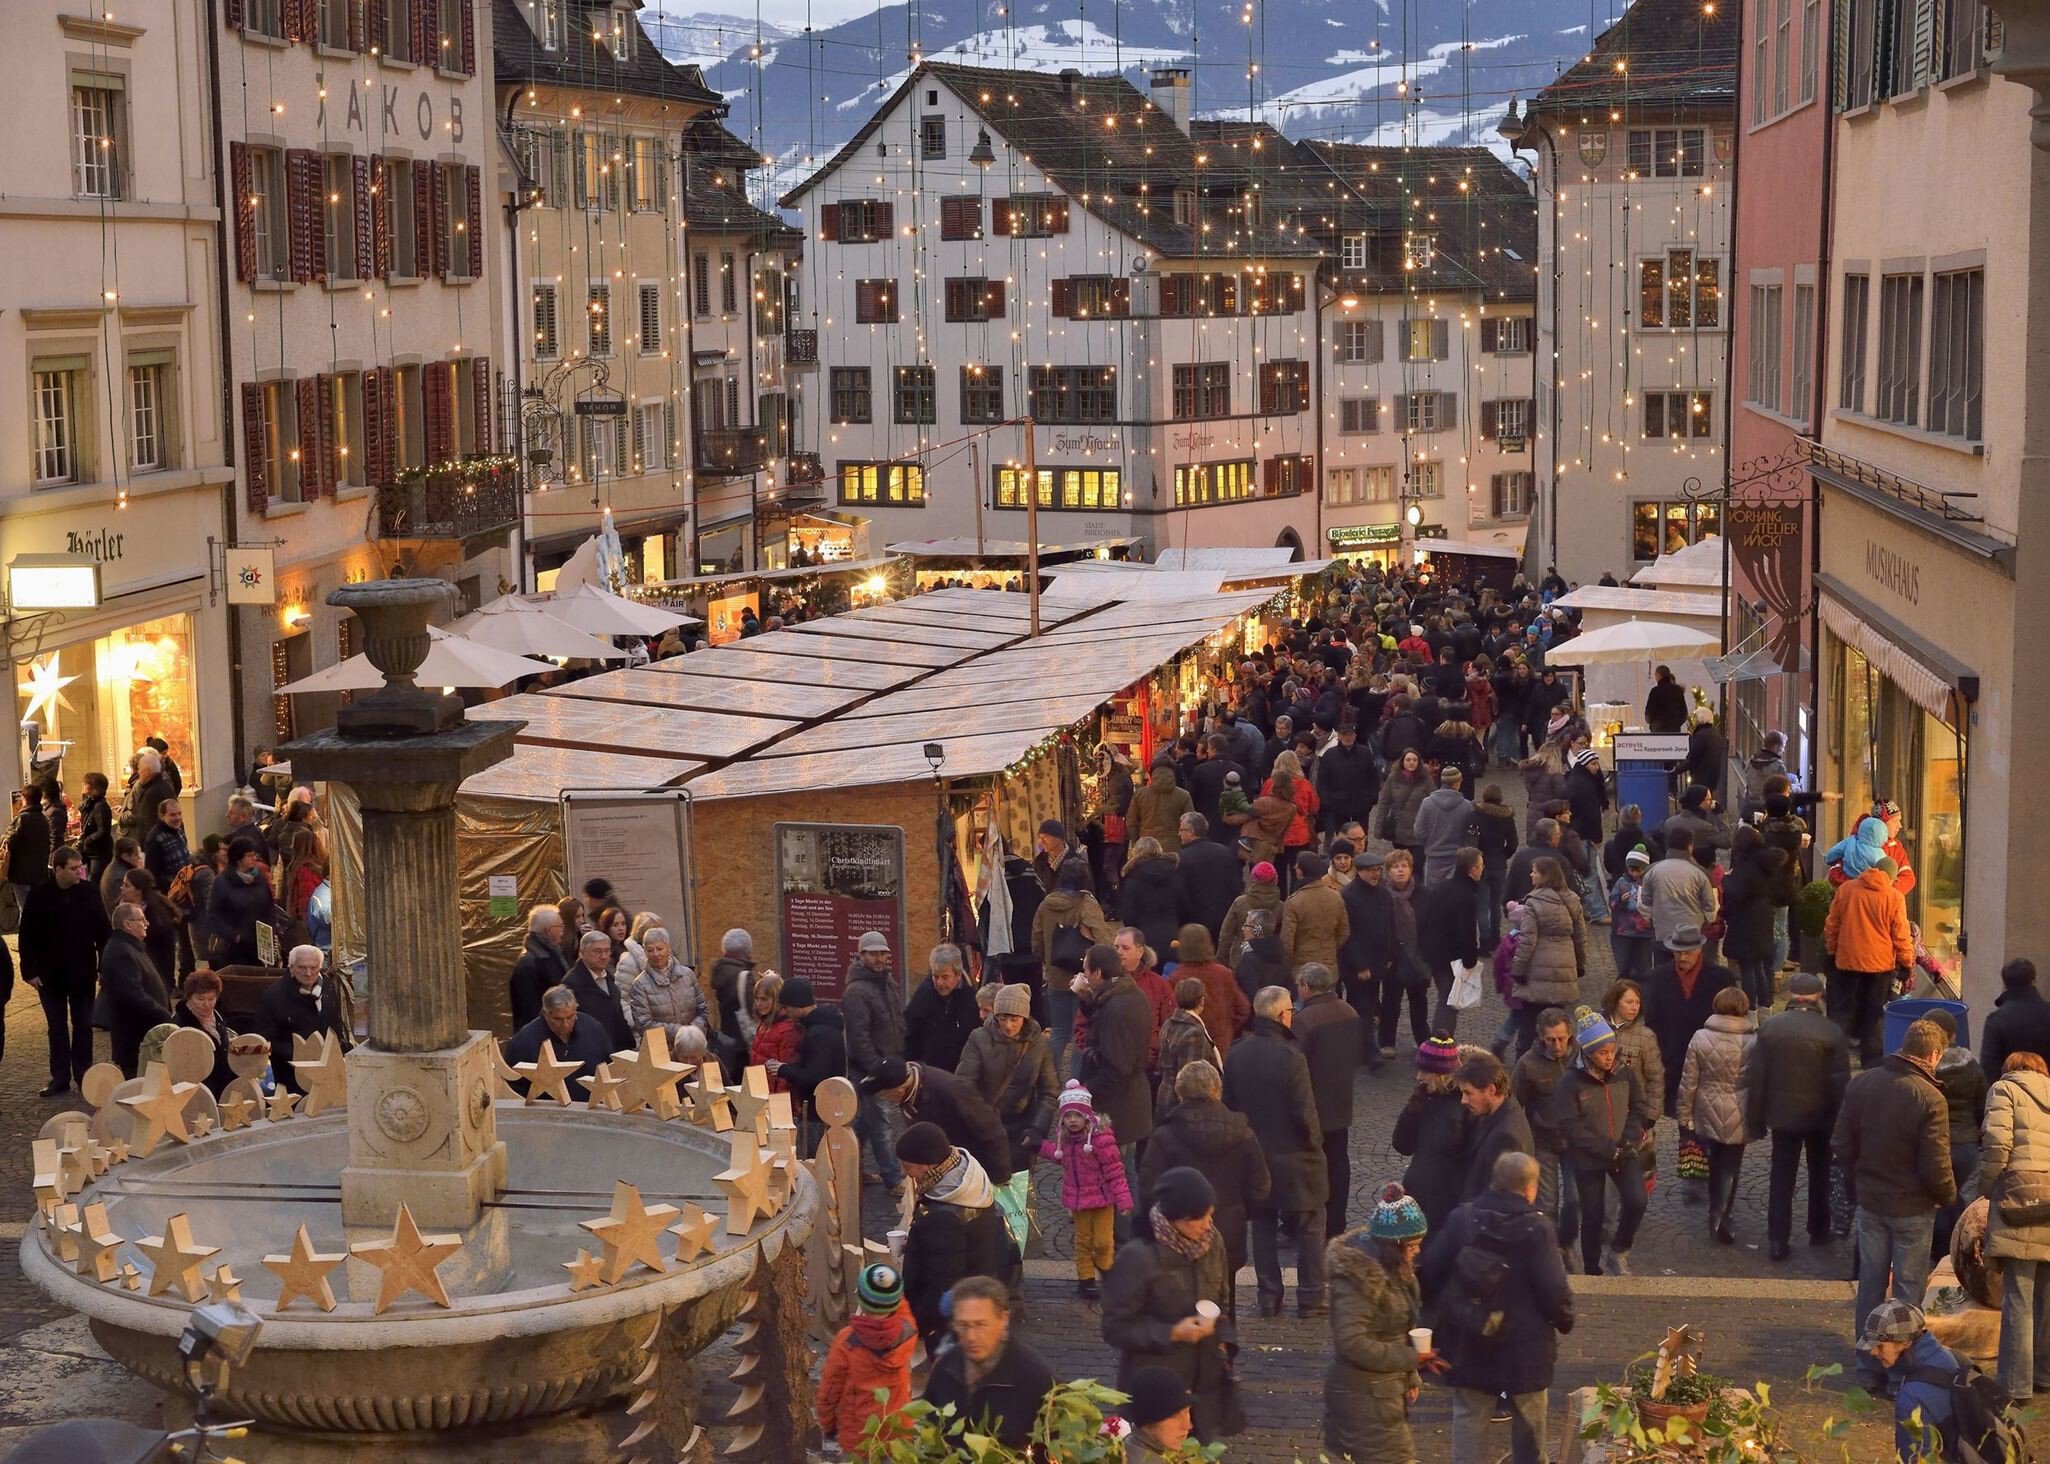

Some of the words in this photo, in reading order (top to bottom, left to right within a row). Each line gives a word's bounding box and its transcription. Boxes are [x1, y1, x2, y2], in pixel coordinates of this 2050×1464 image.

[315, 72, 464, 143] JAKOB
[1056, 431, 1080, 452] Zum
[1728, 510, 1781, 522] VORHANG
[1751, 522, 1799, 535] ATELIER
[66, 527, 124, 562] Hörler
[1743, 534, 1782, 547] WICKI
[1865, 539, 1919, 607] MUSIKHAUS
[670, 600, 685, 608] AIR
[1617, 741, 1643, 749] acrevis
